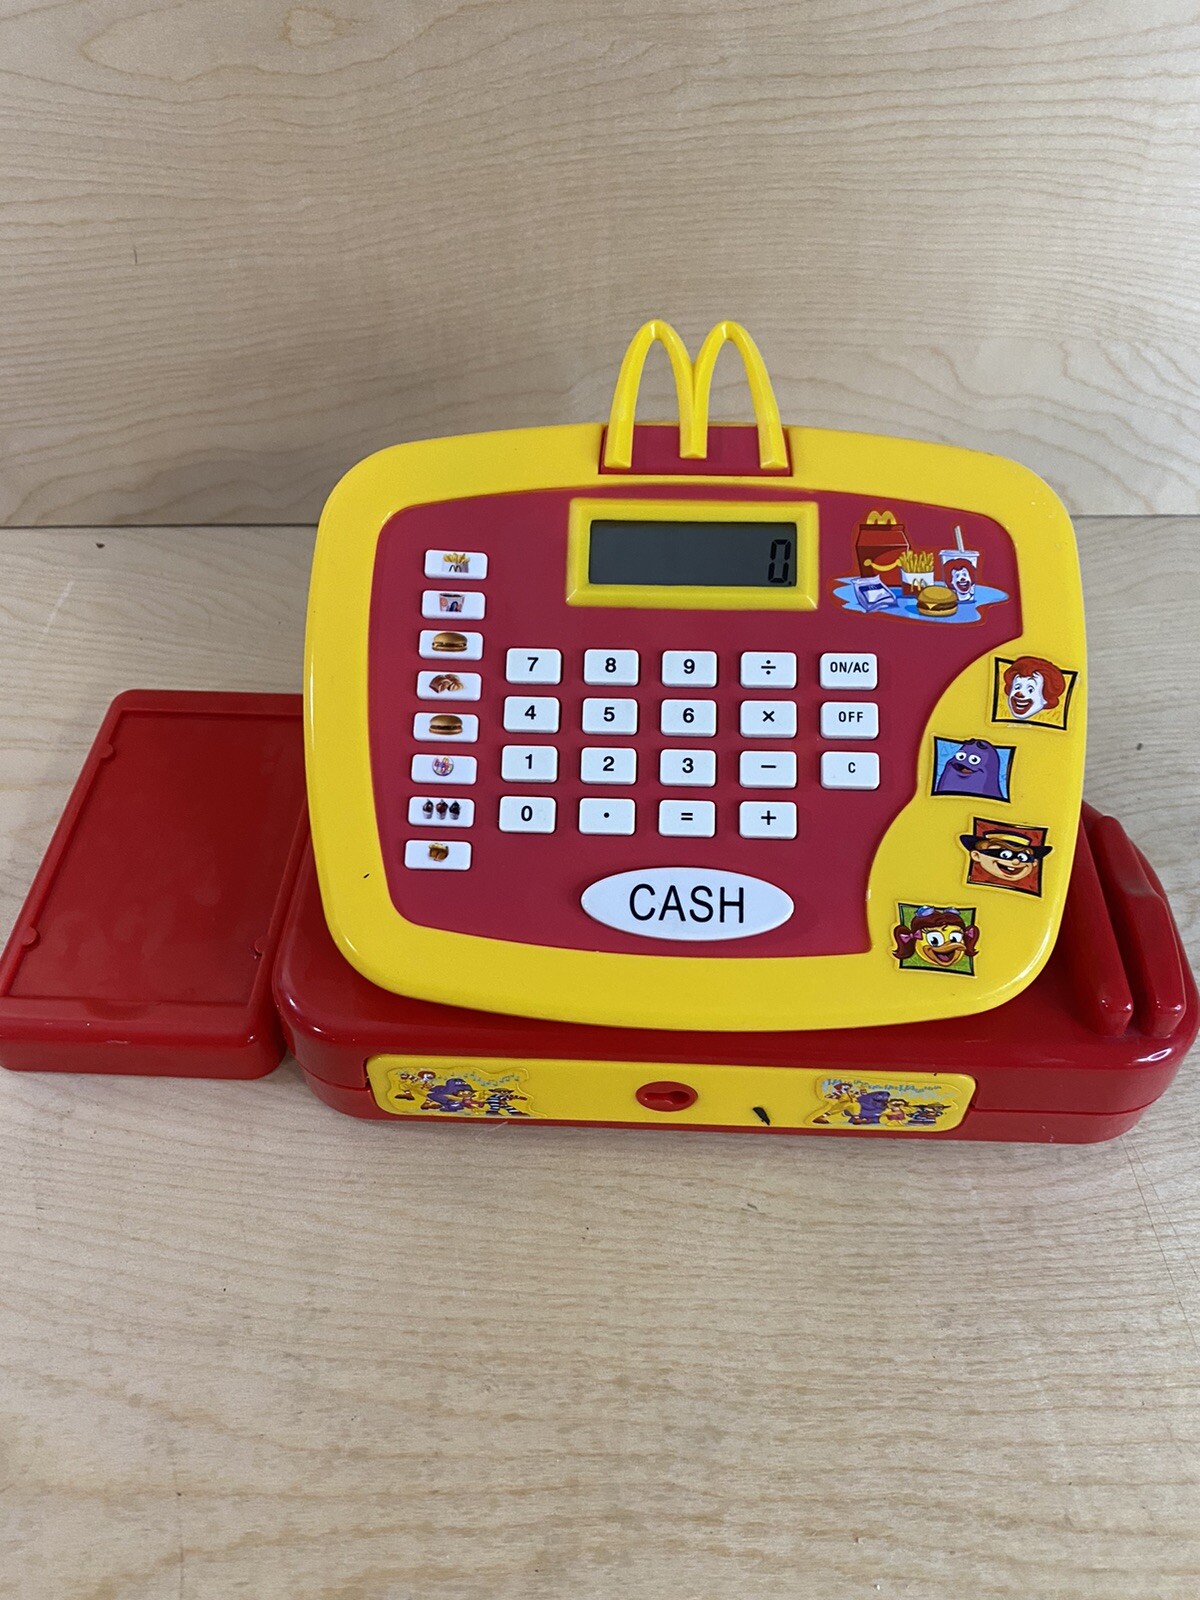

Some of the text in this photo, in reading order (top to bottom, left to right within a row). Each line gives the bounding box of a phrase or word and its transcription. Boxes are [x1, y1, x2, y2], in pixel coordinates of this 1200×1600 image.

[527, 656, 539, 672] 7
[604, 657, 617, 673] 8
[683, 658, 696, 675] 9
[829, 661, 870, 674] ON/AC
[524, 704, 537, 720] 4
[603, 706, 616, 723] 5
[682, 707, 695, 724] 6
[838, 710, 864, 723] OFF
[524, 753, 533, 770] 1
[602, 755, 615, 772] 2
[681, 757, 694, 774] 3
[847, 761, 856, 774] C
[520, 805, 533, 822] 0
[629, 883, 745, 923] CASH
